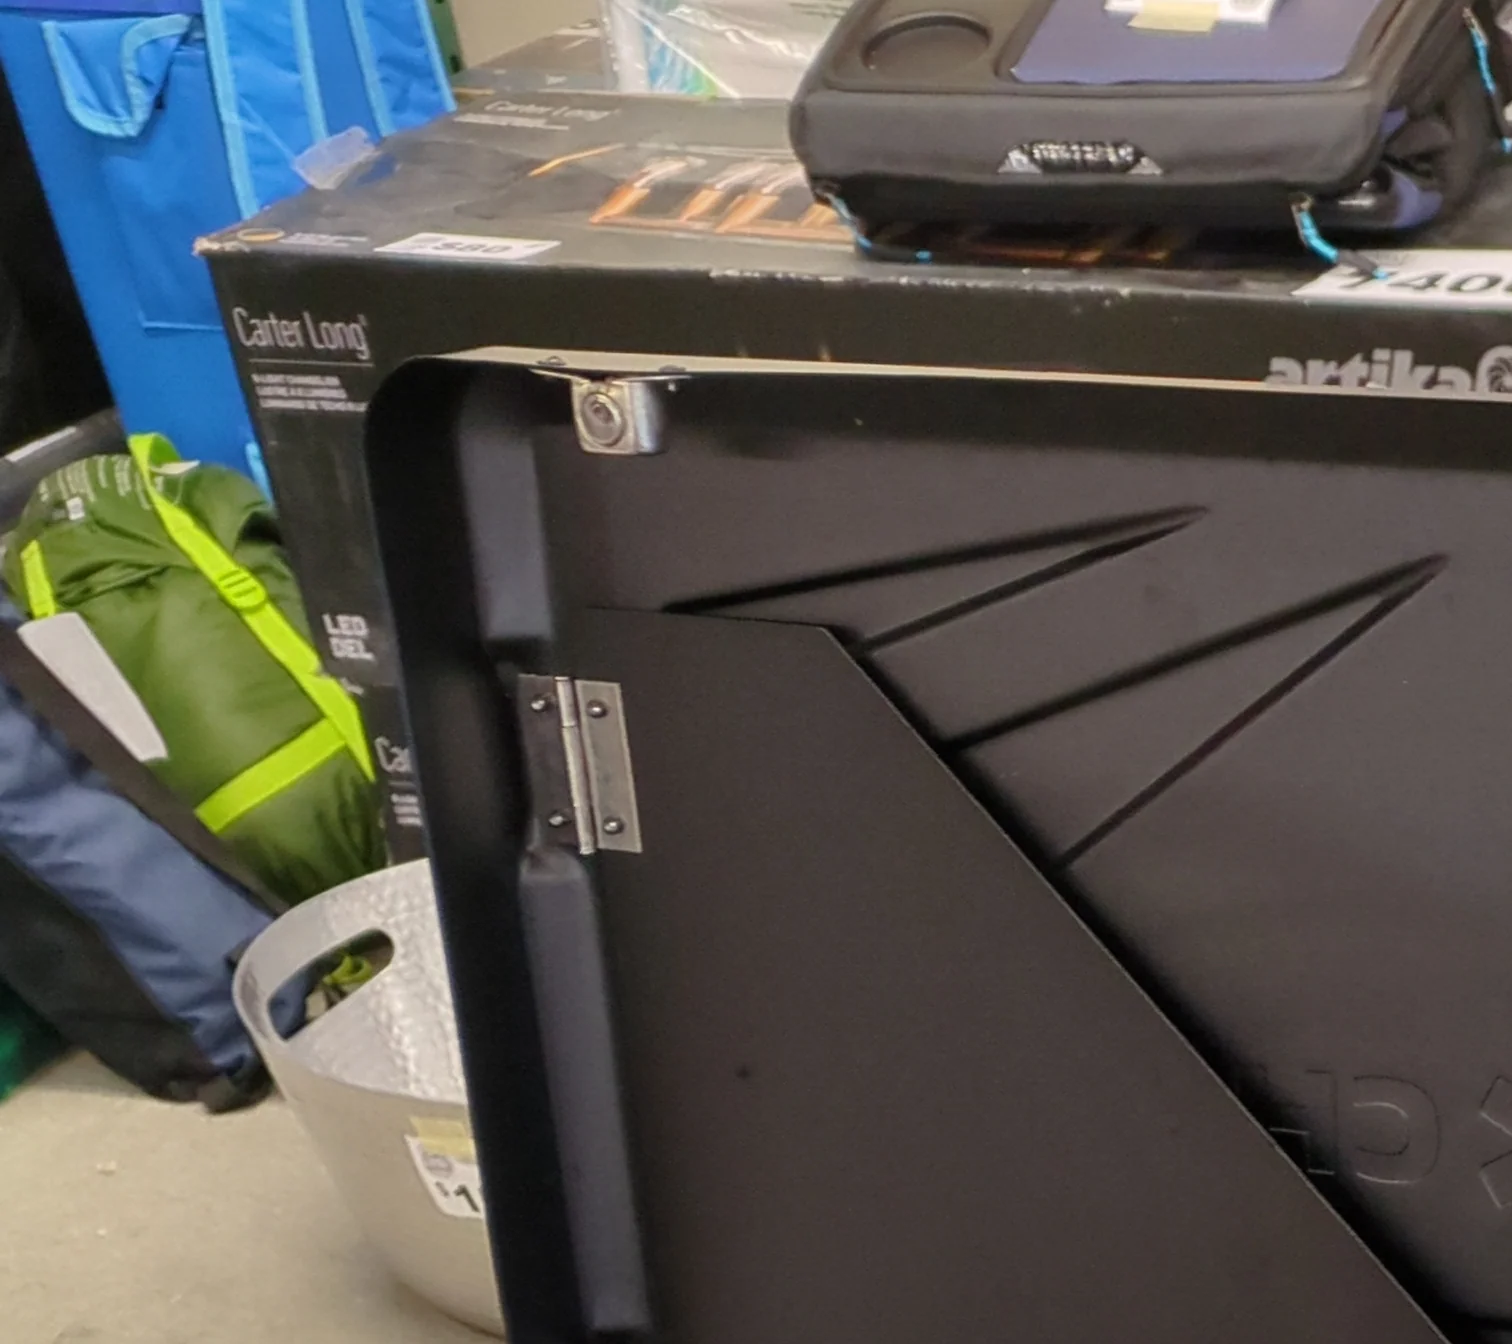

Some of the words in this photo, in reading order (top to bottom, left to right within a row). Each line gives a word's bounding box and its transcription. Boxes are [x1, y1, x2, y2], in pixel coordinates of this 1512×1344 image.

[231, 306, 305, 349] Carter
[302, 310, 371, 360] Long
[1264, 347, 1474, 391] artika
